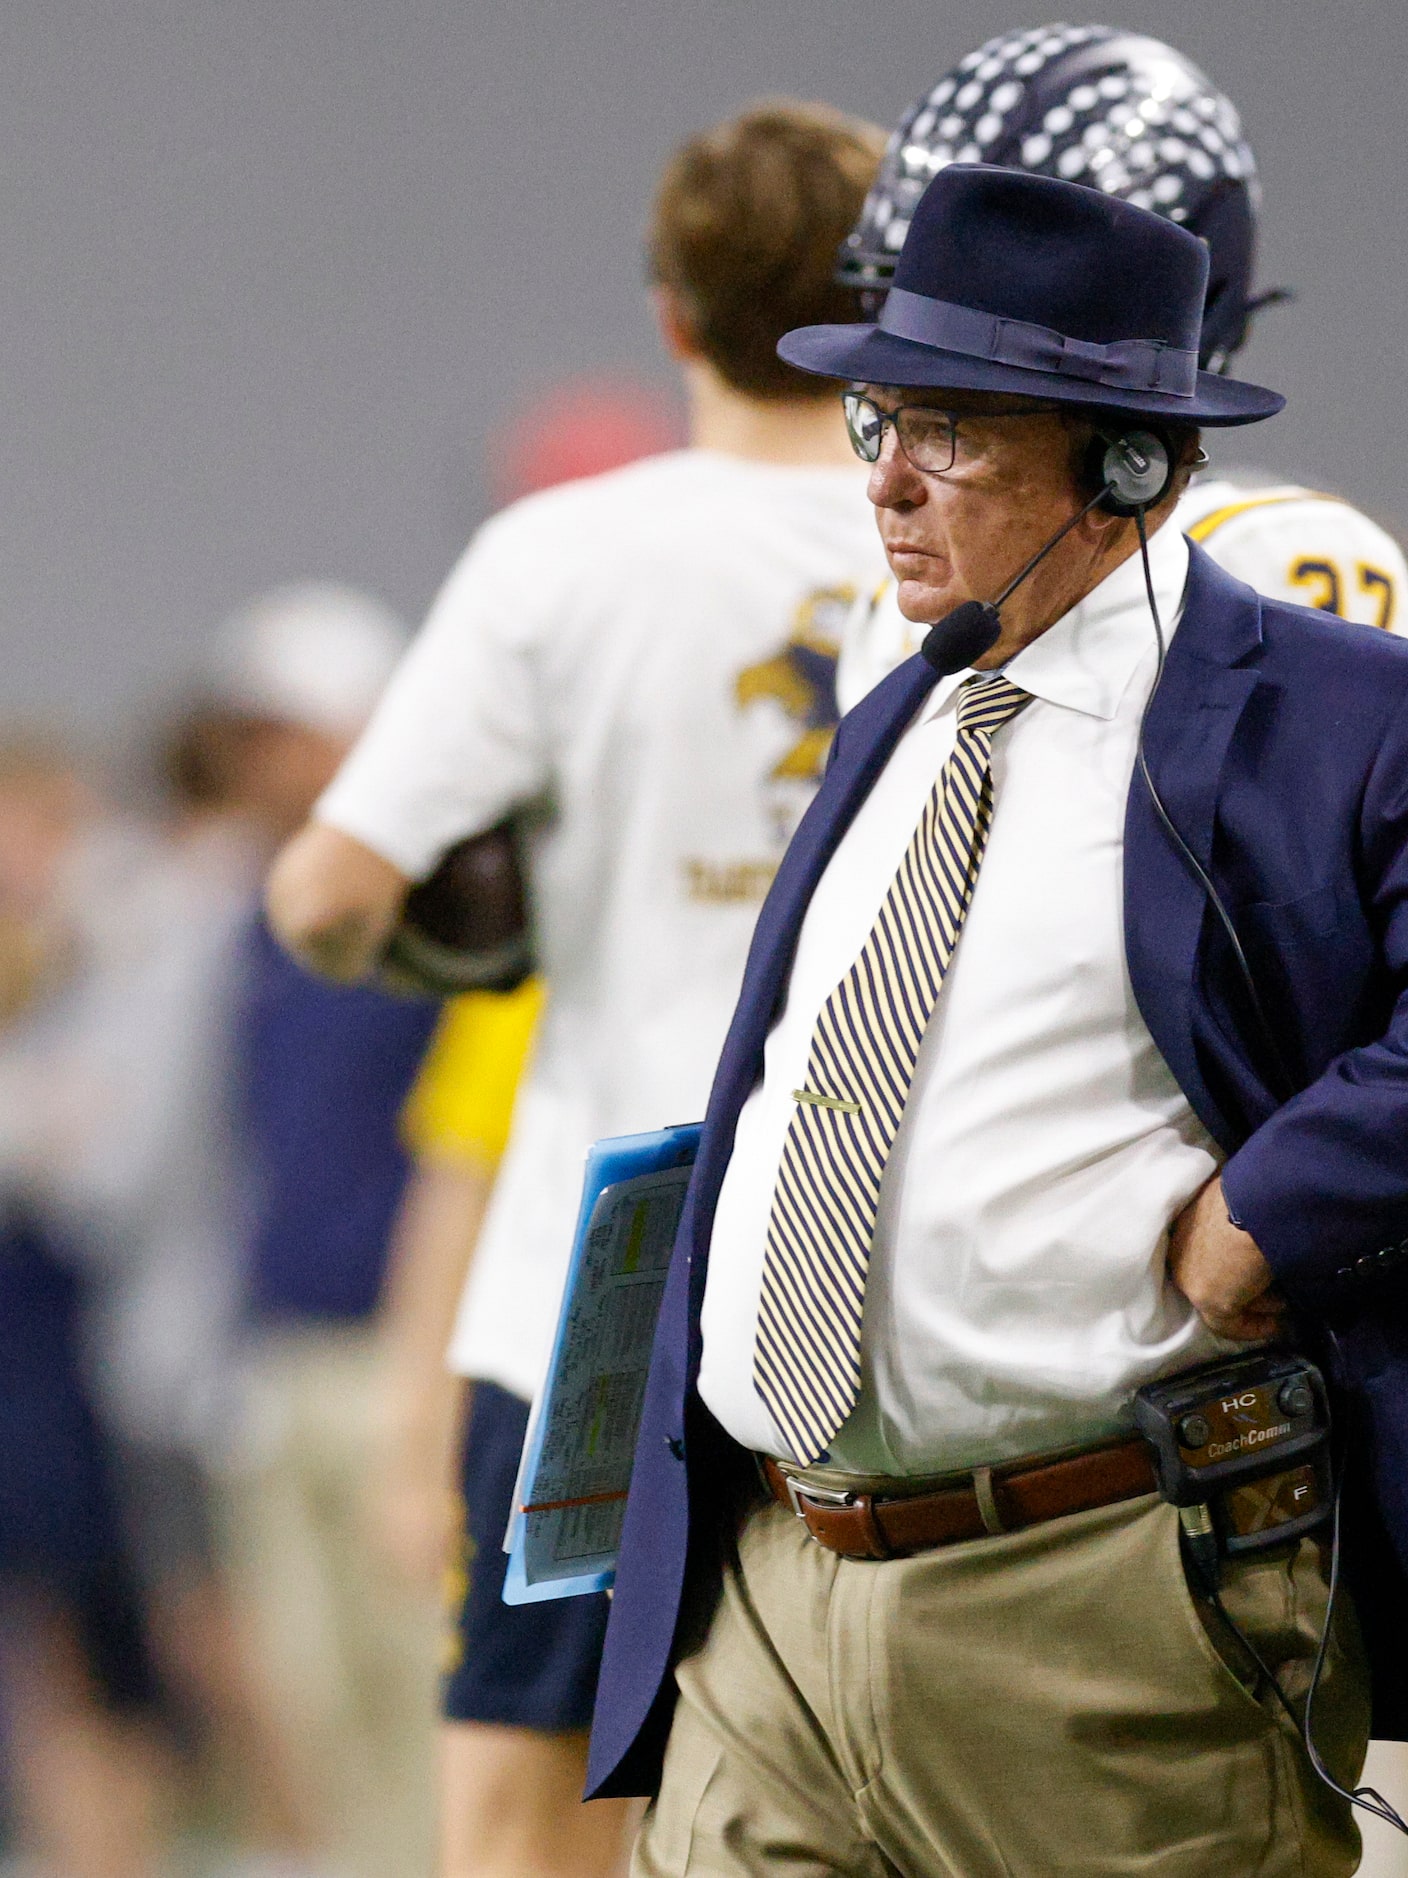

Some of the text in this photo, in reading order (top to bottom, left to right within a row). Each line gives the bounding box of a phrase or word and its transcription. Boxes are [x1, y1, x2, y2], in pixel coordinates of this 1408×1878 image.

[1221, 1393, 1257, 1413] HC
[1208, 1422, 1291, 1458] CoachComm
[1293, 1485, 1309, 1501] F
